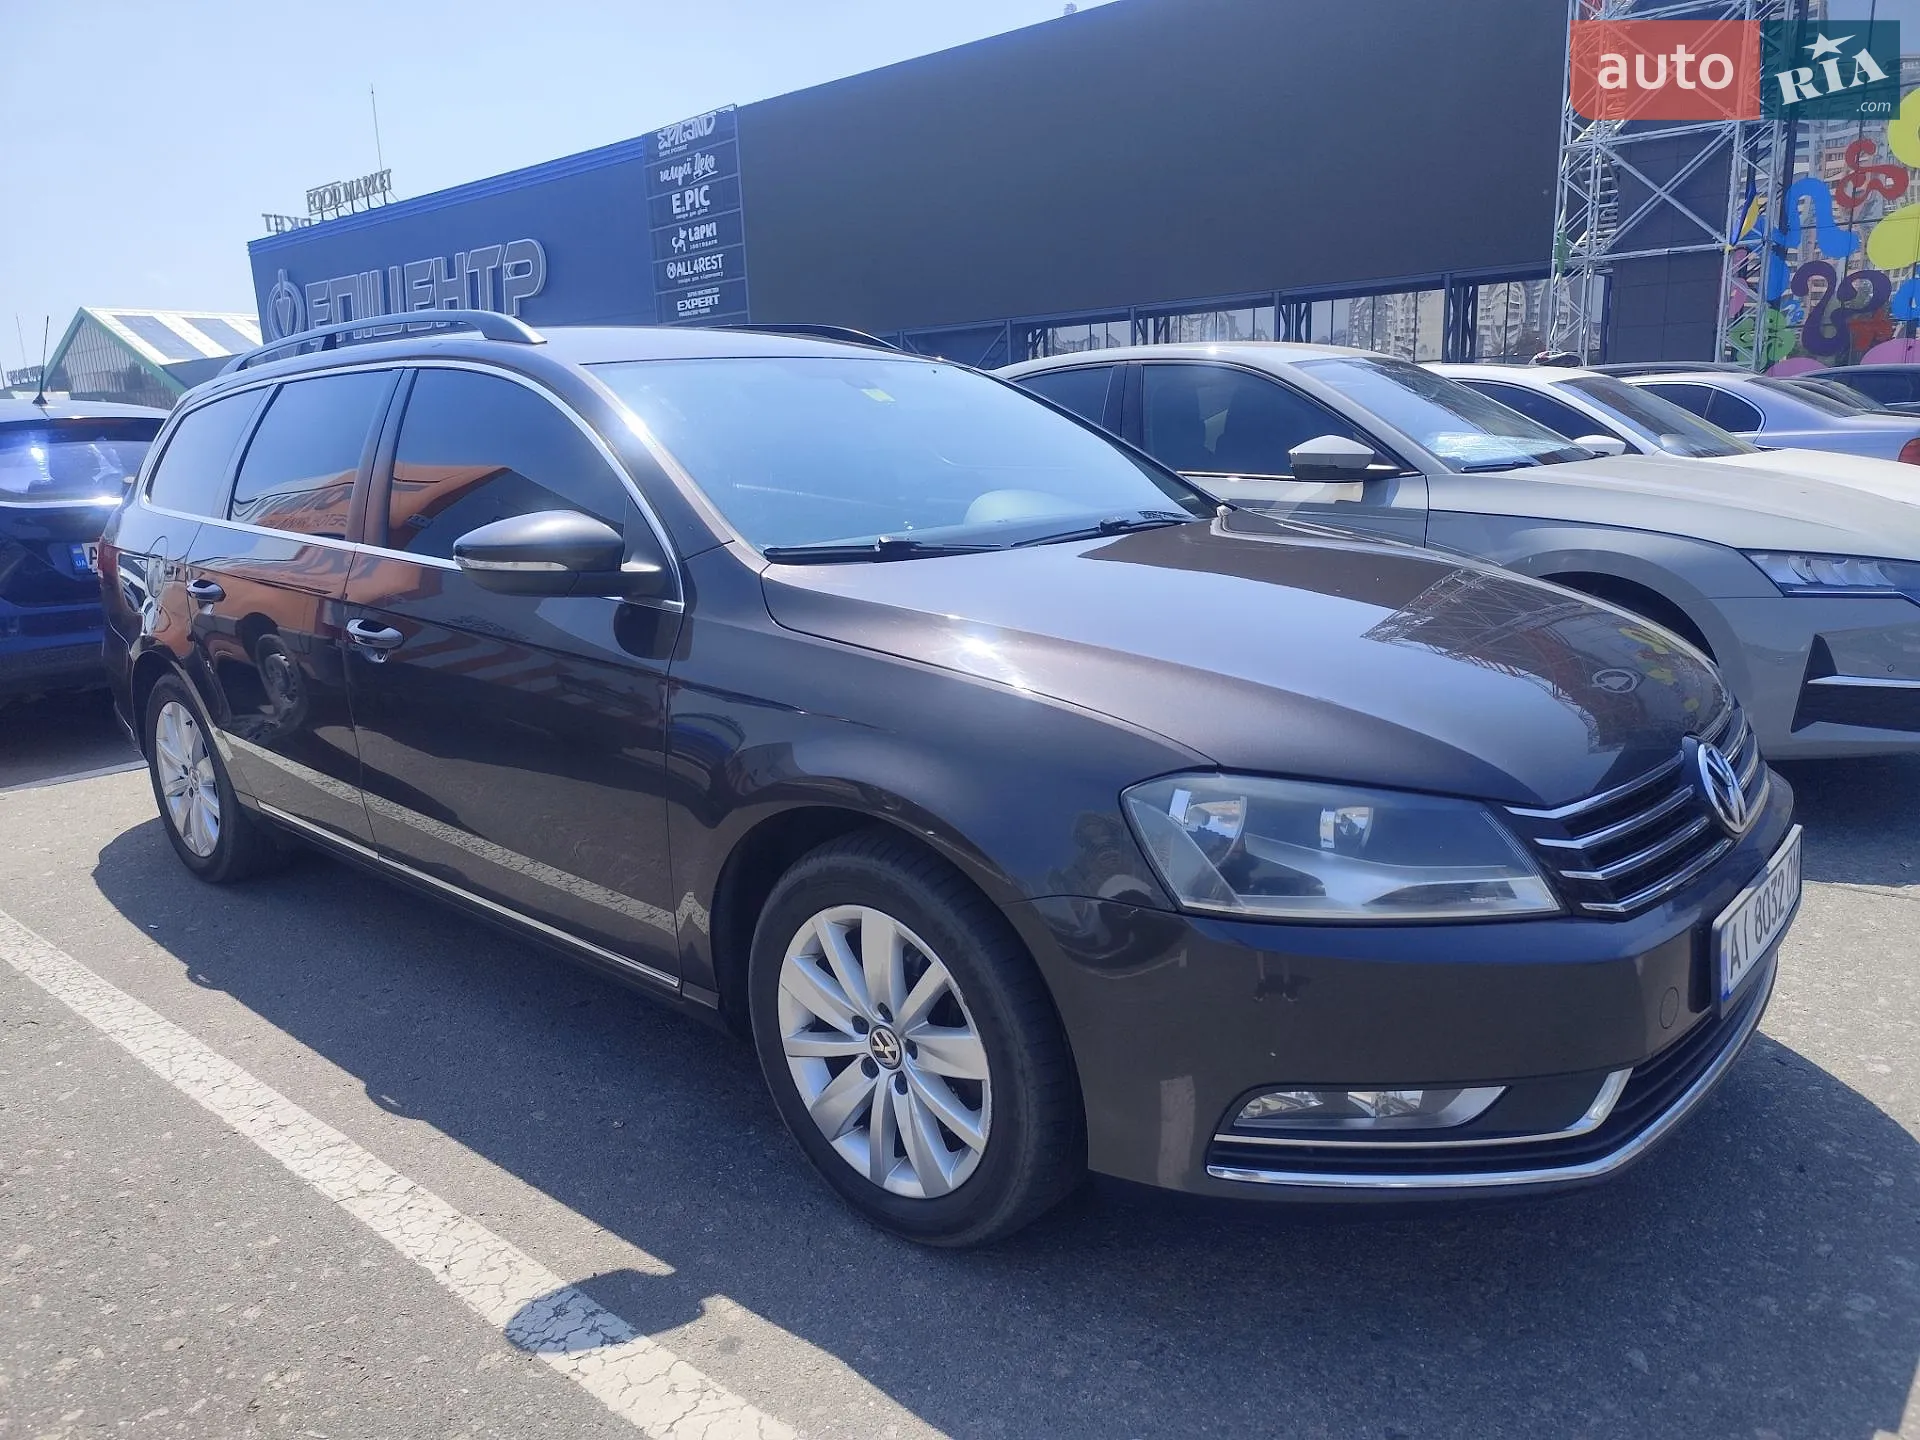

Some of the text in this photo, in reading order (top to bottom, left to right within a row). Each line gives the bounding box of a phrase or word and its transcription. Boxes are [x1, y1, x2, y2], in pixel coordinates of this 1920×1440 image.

[306, 168, 392, 213] FOOD MARKET
[671, 185, 710, 214] E.PIC
[677, 294, 720, 312] EXPERT
[75, 559, 86, 567] UA
[1754, 868, 1785, 945] 8032
